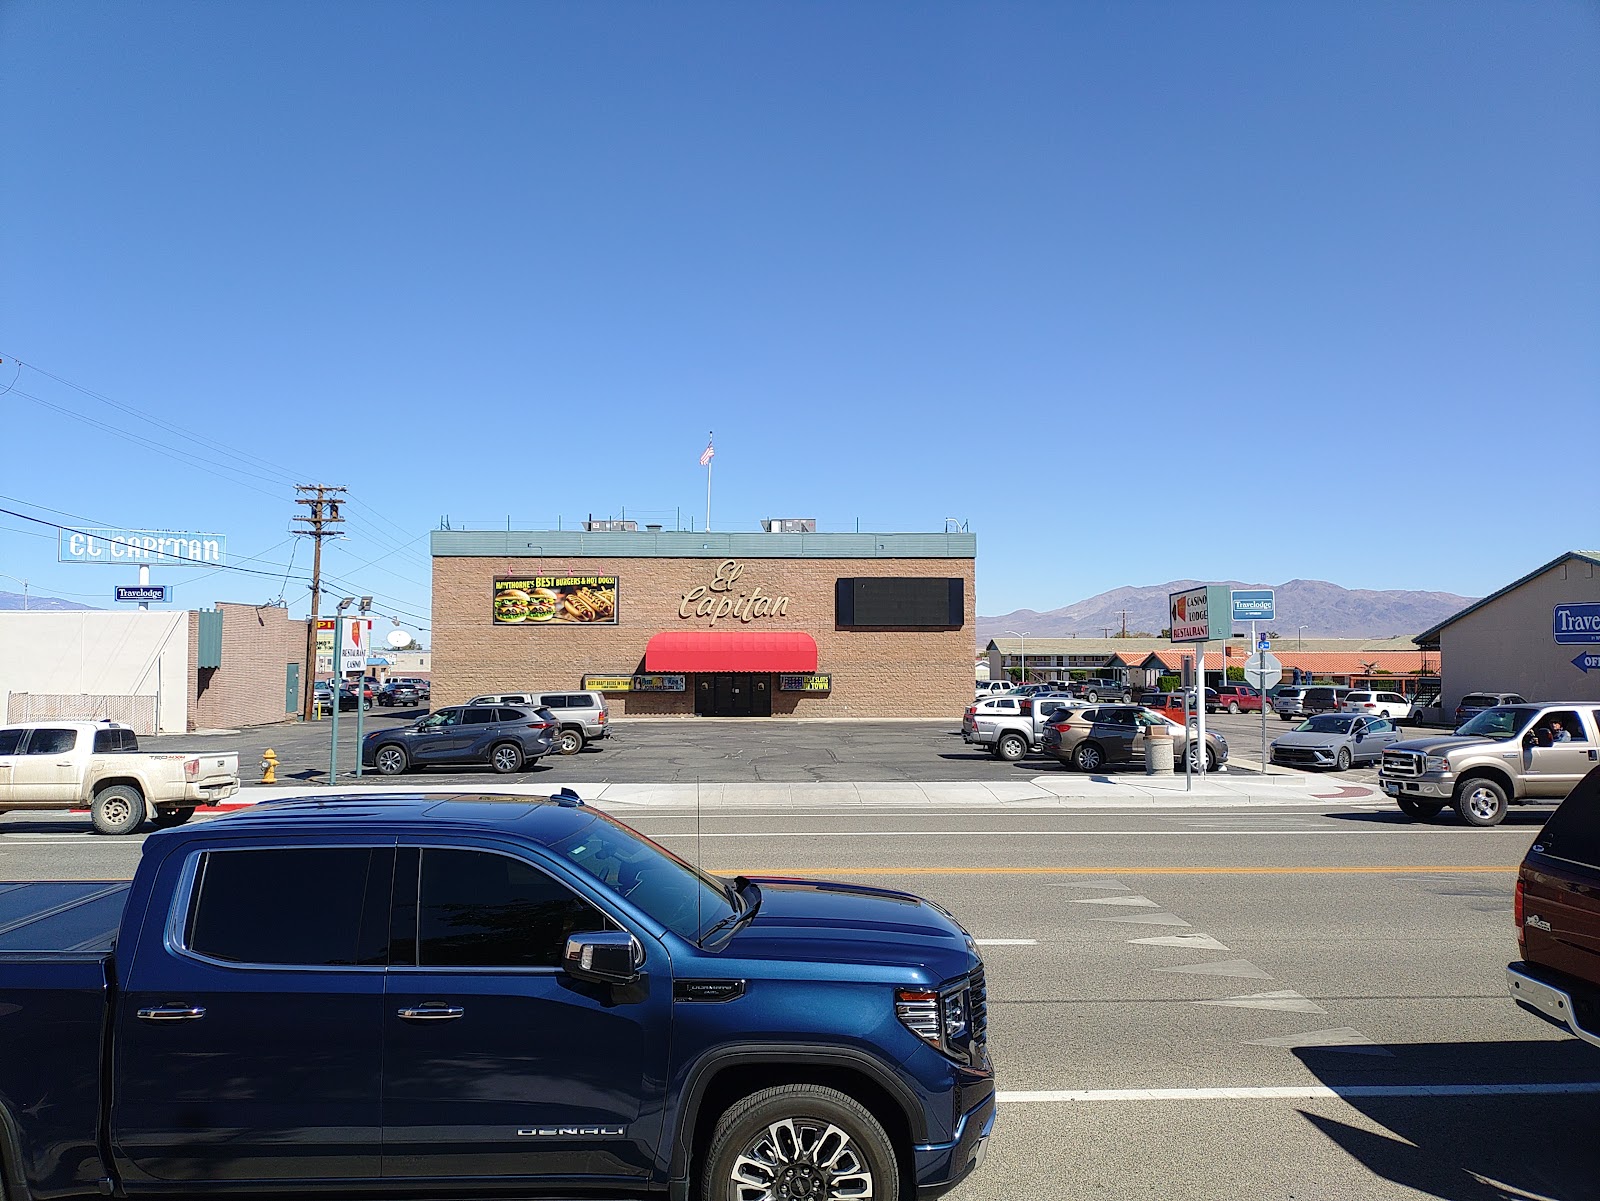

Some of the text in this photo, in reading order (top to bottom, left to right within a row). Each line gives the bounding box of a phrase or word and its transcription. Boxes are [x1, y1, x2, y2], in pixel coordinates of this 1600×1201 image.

[709, 559, 744, 591] El
[535, 577, 555, 588] BEST
[556, 578, 580, 586] BURGERS
[118, 588, 162, 599] Travelodge
[1187, 594, 1207, 607] CASINO
[1235, 600, 1272, 609] Travelodge
[679, 587, 790, 626] Capitan
[1189, 610, 1208, 621] LODGE
[1173, 625, 1208, 638] RESTAURANT
[517, 1127, 624, 1136] DENALI
